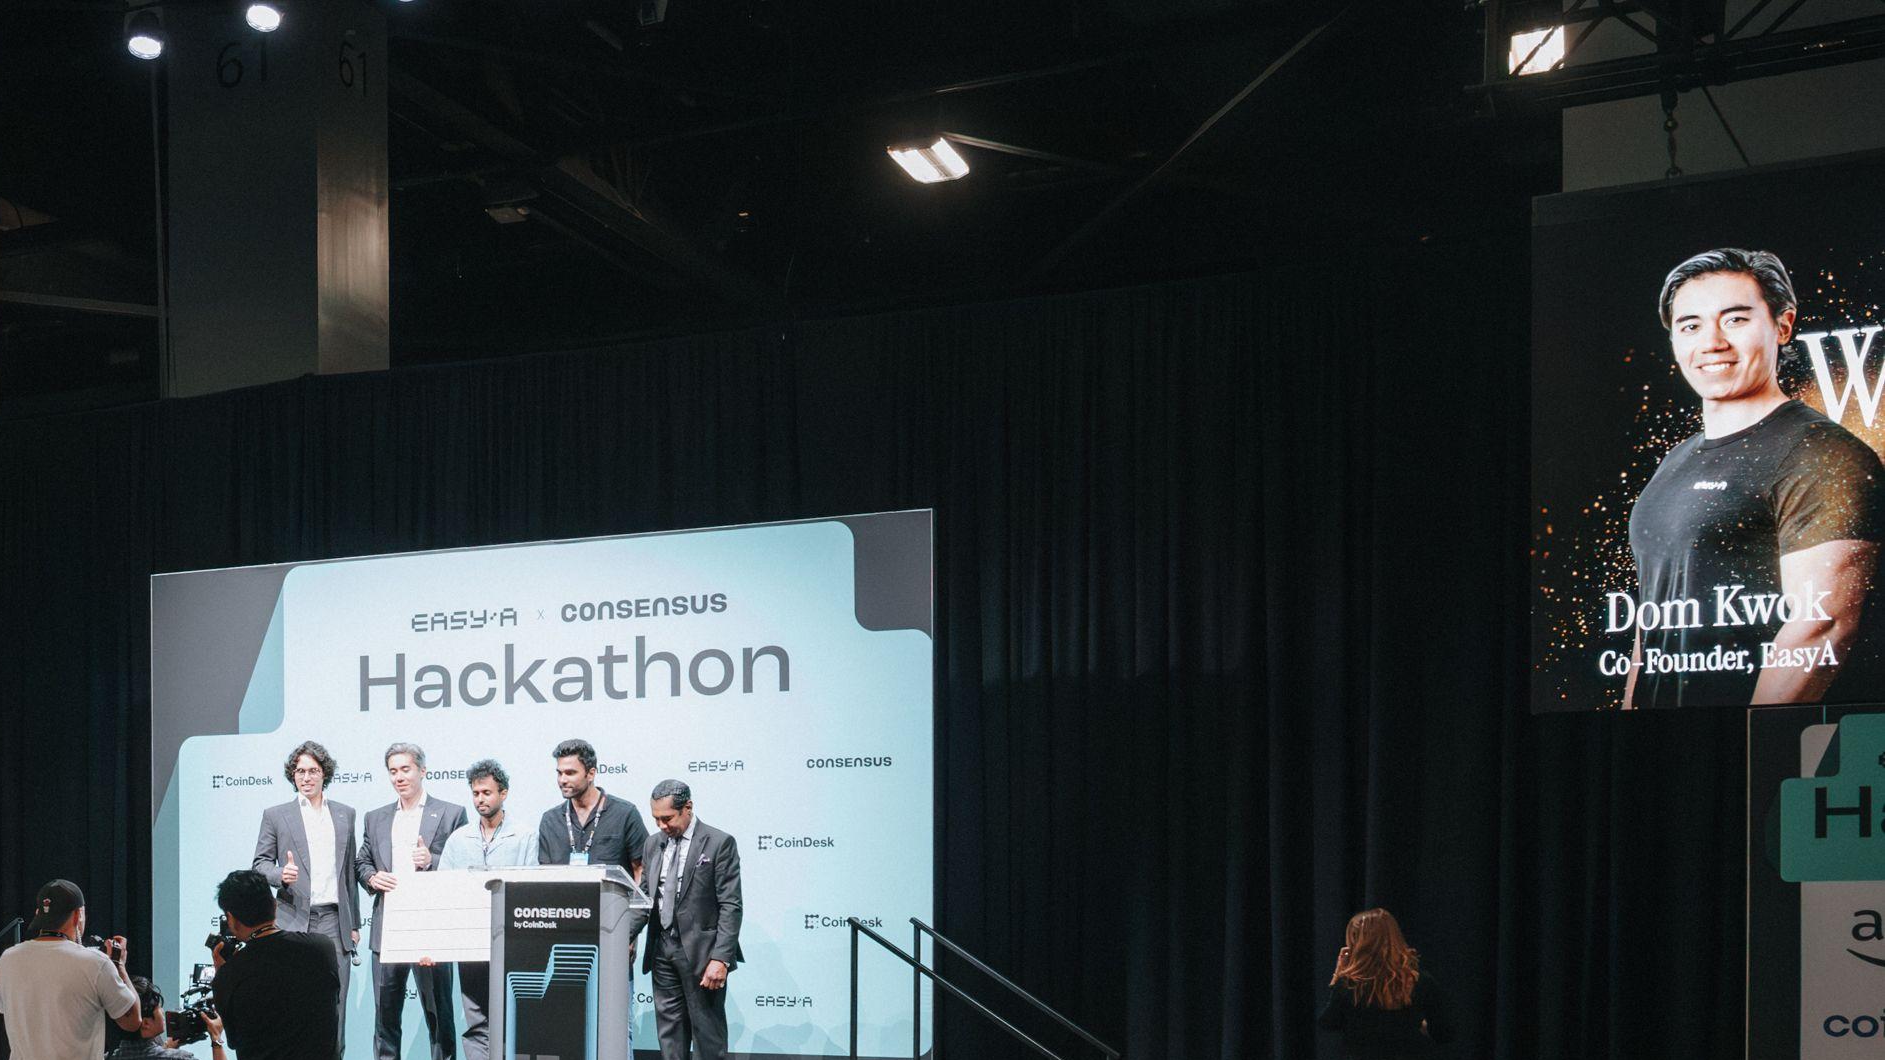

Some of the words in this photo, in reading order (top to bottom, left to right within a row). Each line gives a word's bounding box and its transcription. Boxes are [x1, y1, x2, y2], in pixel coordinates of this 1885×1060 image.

[338, 39, 368, 98] 61
[560, 591, 729, 624] CONSENSUS
[1604, 591, 1704, 635] Dom
[1712, 580, 1834, 629] Kwok
[1598, 643, 1755, 676] Co-Founder,
[1759, 638, 1840, 673] EasyA
[359, 634, 791, 713] Hackathon
[806, 756, 893, 769] CONSENSUS
[225, 775, 274, 787] CoinDesk
[425, 770, 466, 781] CONSE
[774, 836, 835, 849] CoinDesk
[513, 907, 592, 919] CONSENSUS
[513, 920, 523, 929] by
[522, 920, 558, 929] CoinDesk
